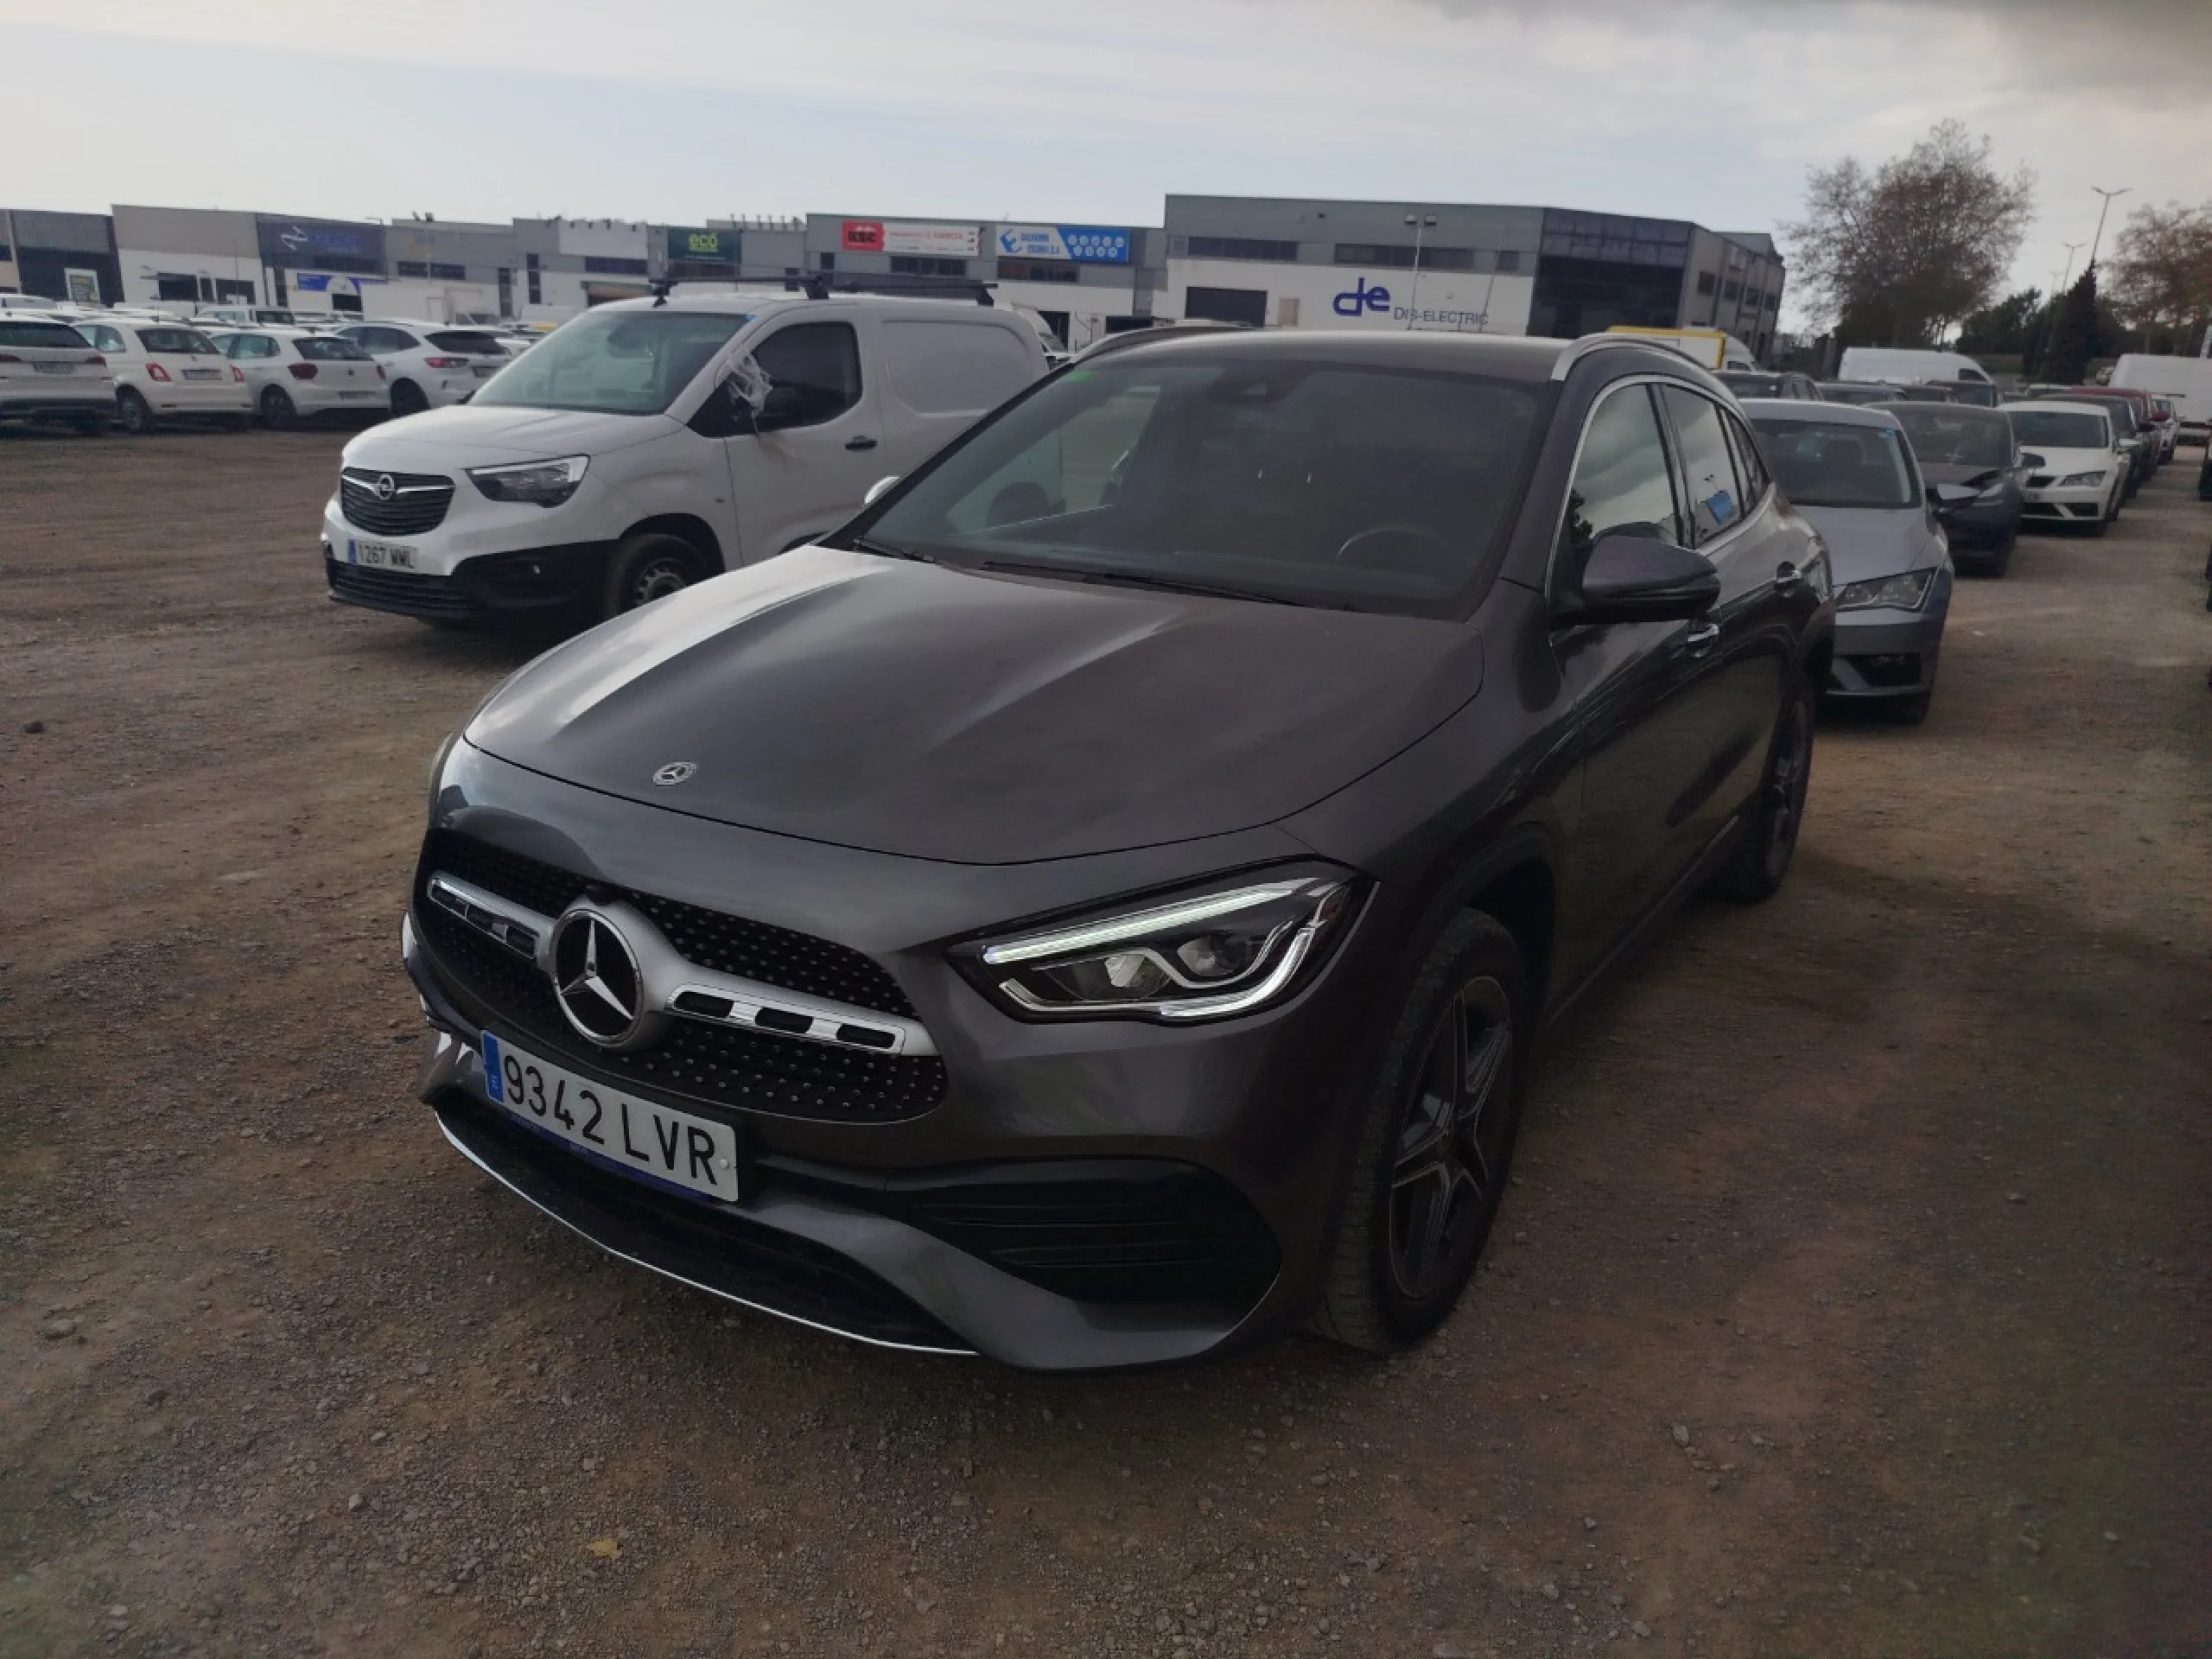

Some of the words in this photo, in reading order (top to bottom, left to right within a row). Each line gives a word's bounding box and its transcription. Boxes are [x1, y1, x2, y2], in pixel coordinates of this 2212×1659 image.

[1332, 276, 1391, 317] de
[1394, 307, 1489, 326] DIS-ELECTRIC
[504, 1055, 605, 1145] 9342
[621, 1103, 718, 1185] LVR
